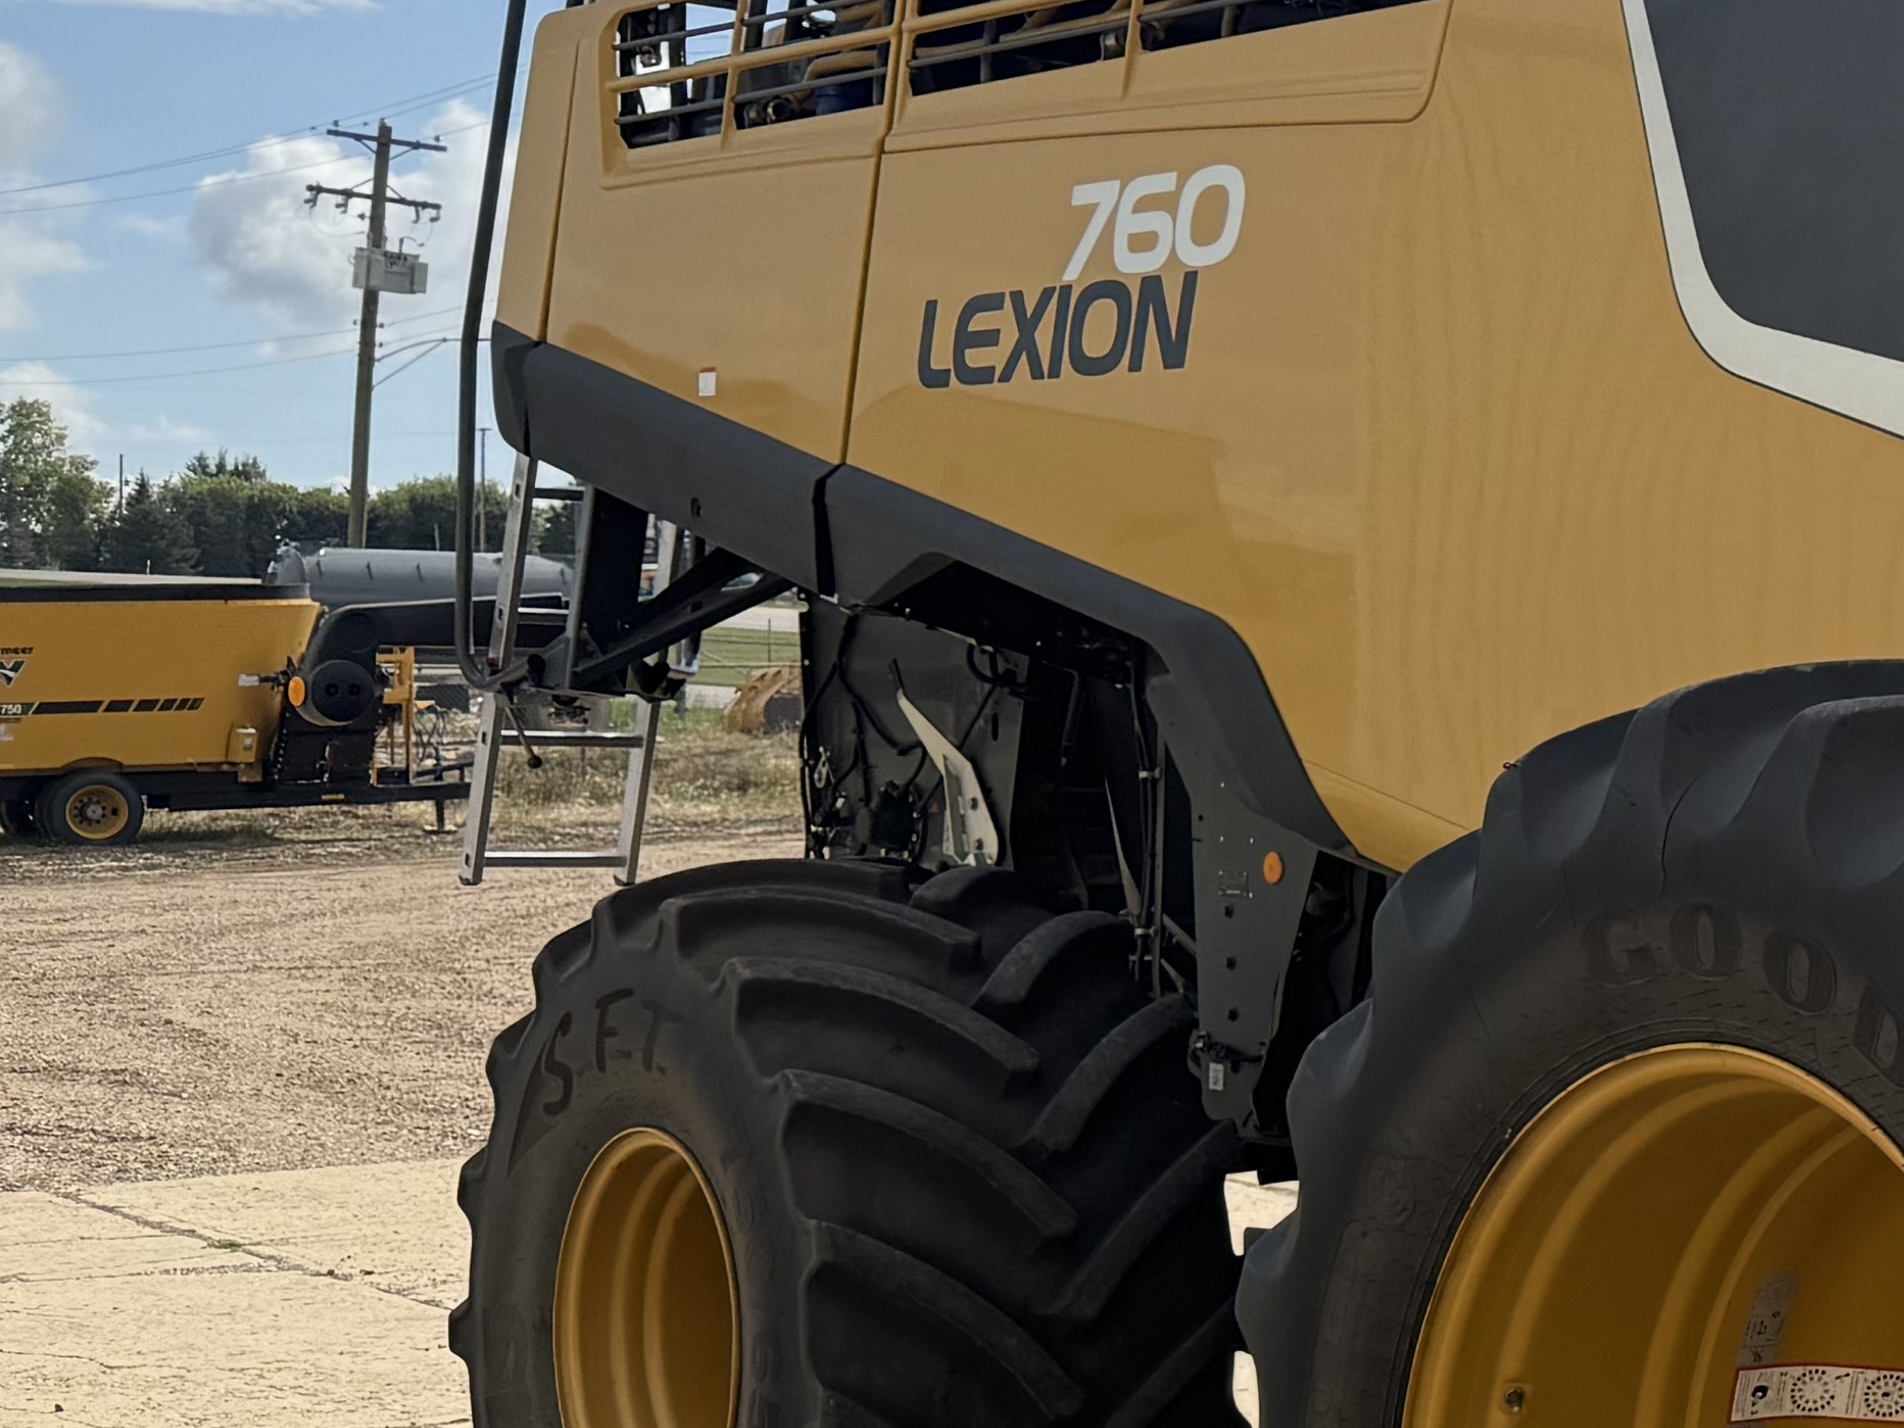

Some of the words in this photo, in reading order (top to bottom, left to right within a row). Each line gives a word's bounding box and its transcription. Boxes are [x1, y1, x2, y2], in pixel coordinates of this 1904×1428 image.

[1062, 164, 1246, 282] 760
[917, 270, 1199, 389] LEXION
[0, 646, 34, 656] meer
